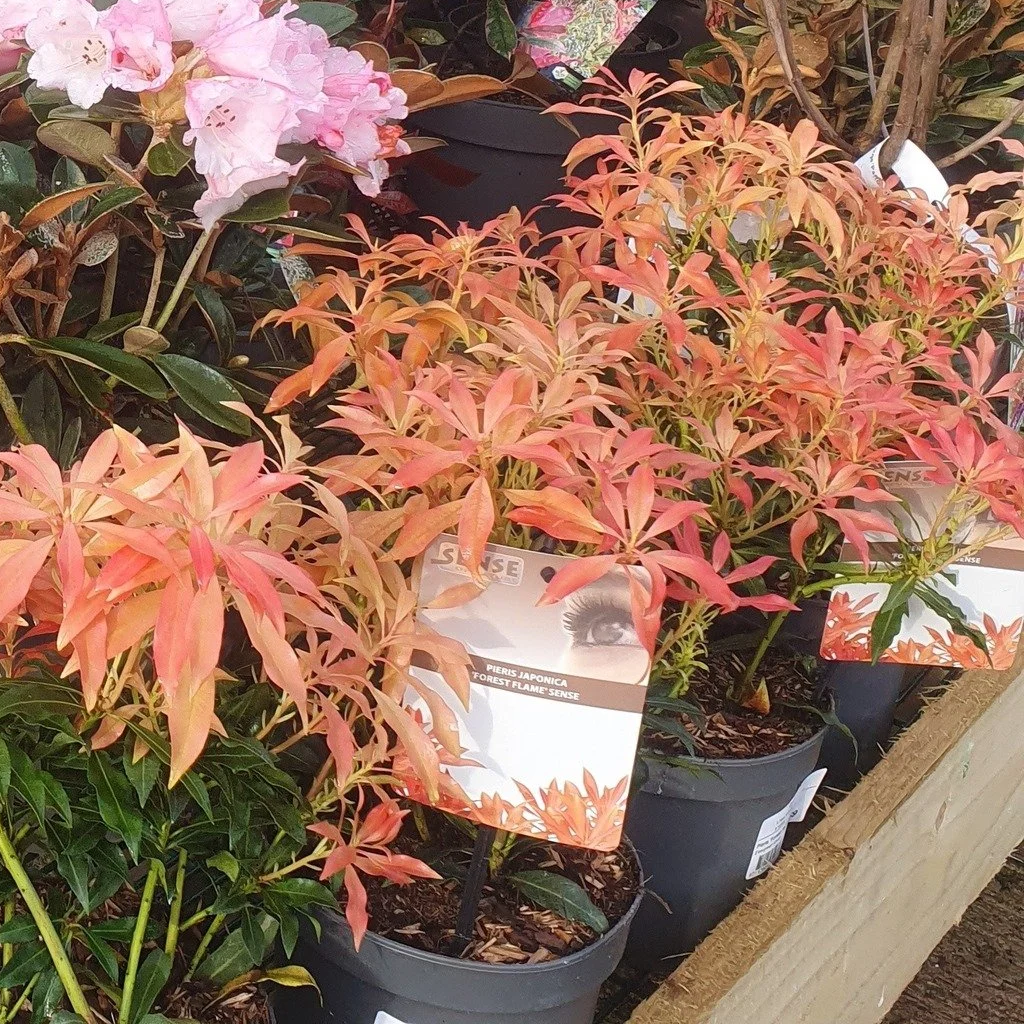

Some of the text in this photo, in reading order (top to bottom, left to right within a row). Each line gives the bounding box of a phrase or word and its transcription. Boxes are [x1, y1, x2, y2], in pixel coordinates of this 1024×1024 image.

[486, 663, 568, 688] PIERIS JAPONICA
[548, 687, 580, 701] SENSE
